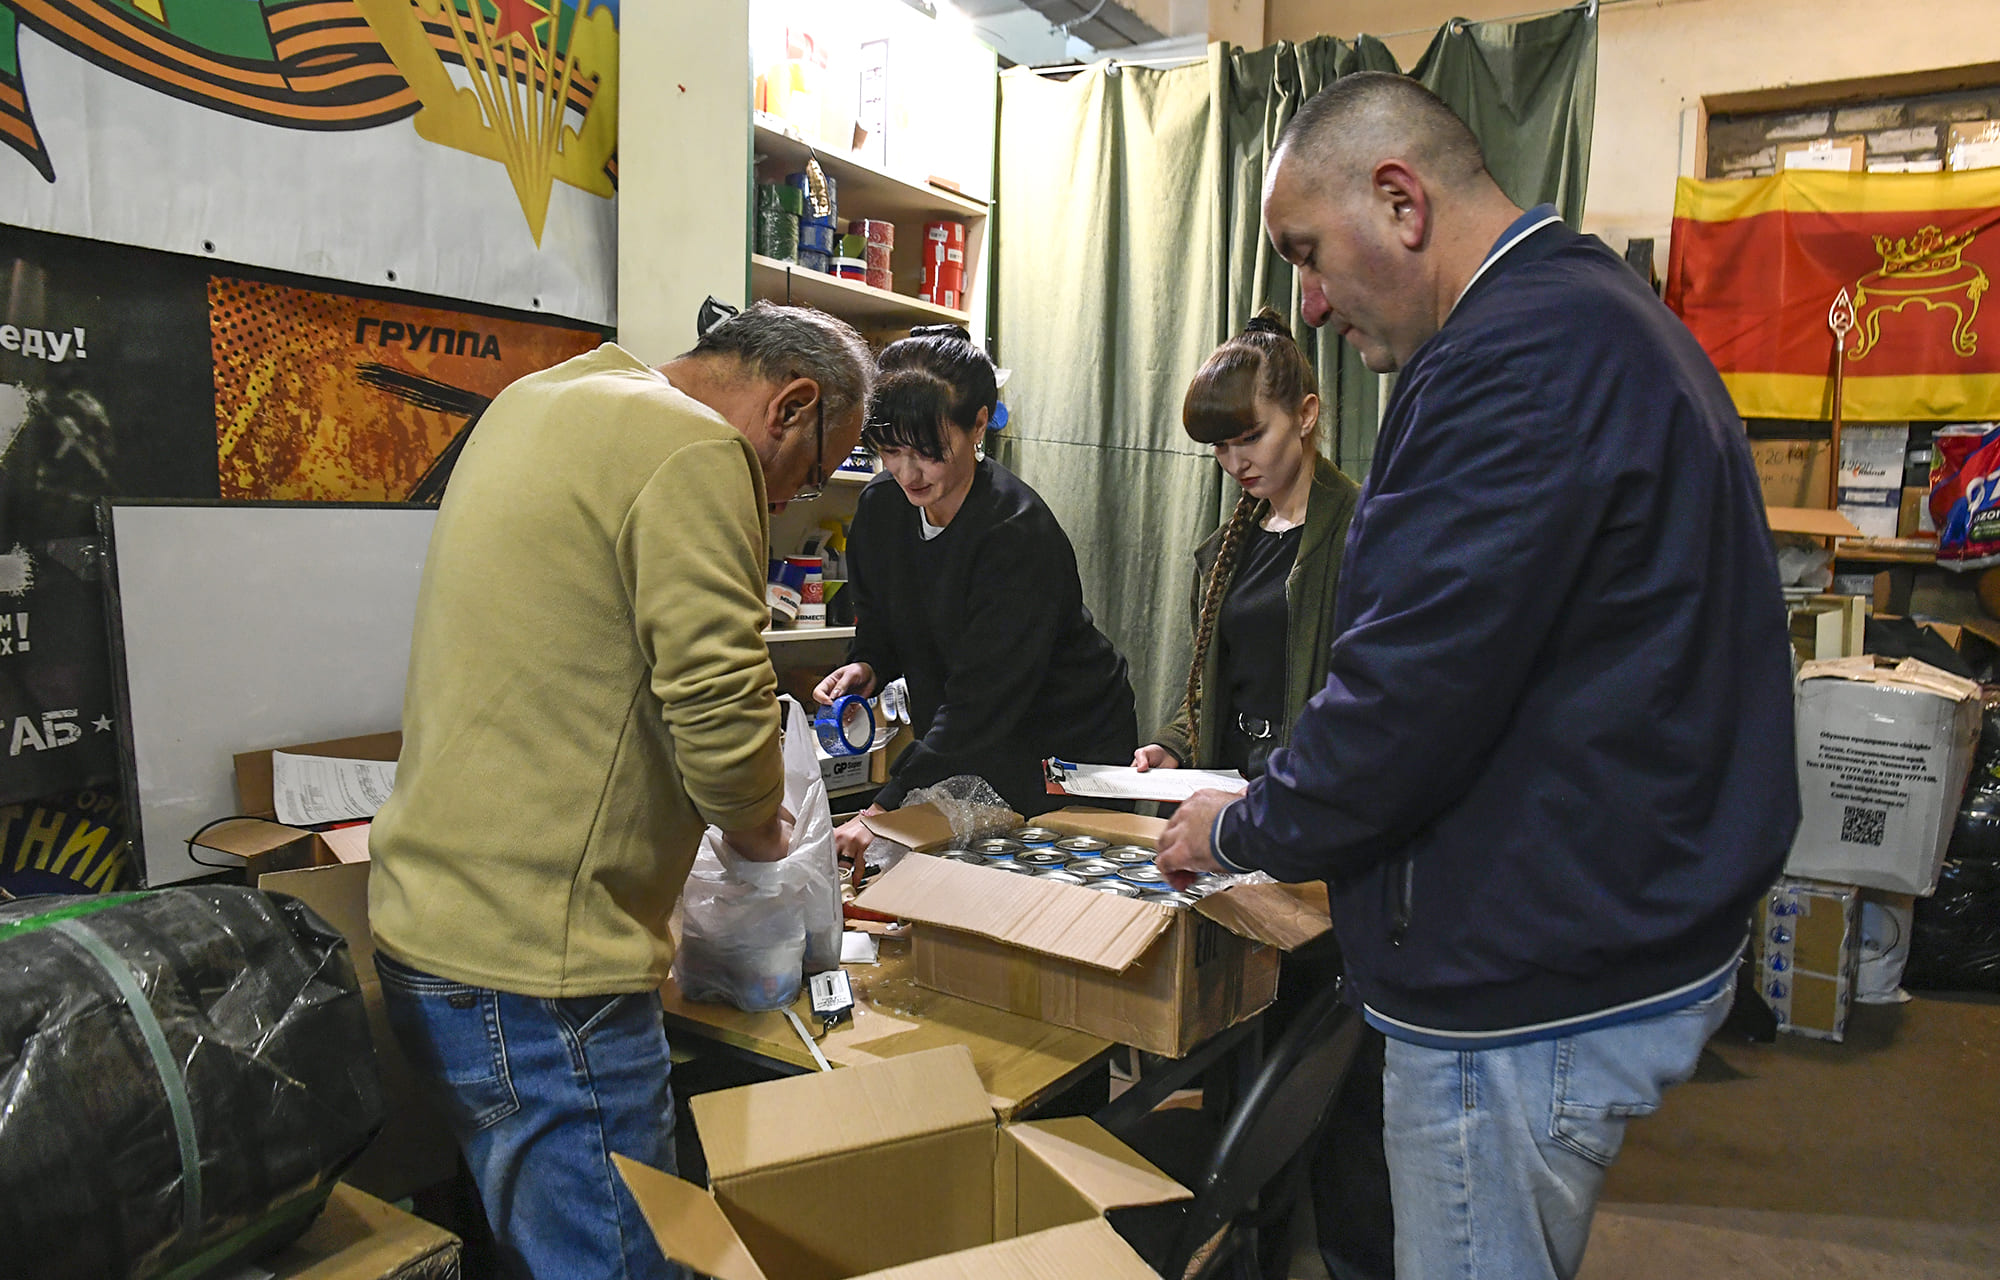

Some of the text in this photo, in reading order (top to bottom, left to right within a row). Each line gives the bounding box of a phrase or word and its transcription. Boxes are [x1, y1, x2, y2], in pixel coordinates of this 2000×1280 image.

[355, 317, 502, 361] ГРУППА
[0, 708, 82, 757] АБ
[833, 762, 848, 775] GP
